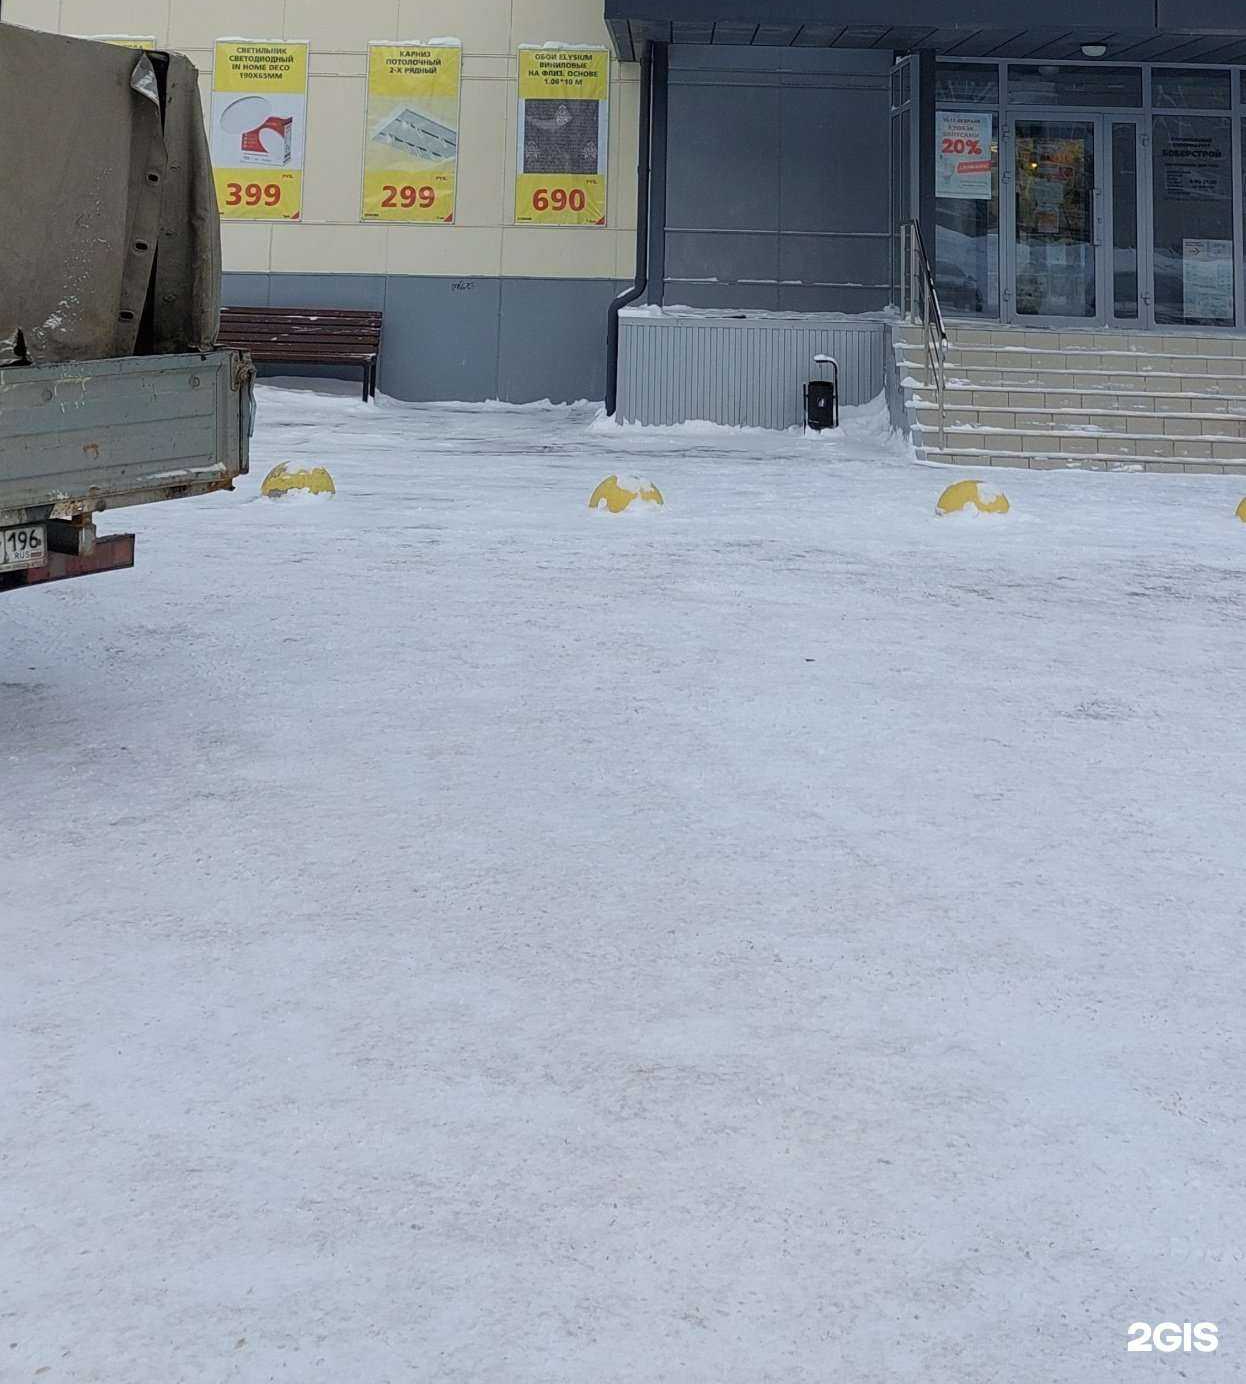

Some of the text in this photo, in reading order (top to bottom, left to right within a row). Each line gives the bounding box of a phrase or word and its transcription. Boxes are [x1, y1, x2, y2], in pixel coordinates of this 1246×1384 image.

[228, 55, 294, 63] СВЕТОДИОДНЫЙ
[399, 50, 431, 58] КАРНИЗ
[385, 57, 442, 66] ПОТОЛОЧНЫЙ
[404, 66, 437, 74] РЯДНЫЙ
[942, 138, 982, 155] 20%
[225, 182, 281, 206] 399
[381, 185, 435, 208] 299
[532, 188, 586, 212] 690
[7, 529, 39, 552] 196
[14, 550, 31, 560] RUS
